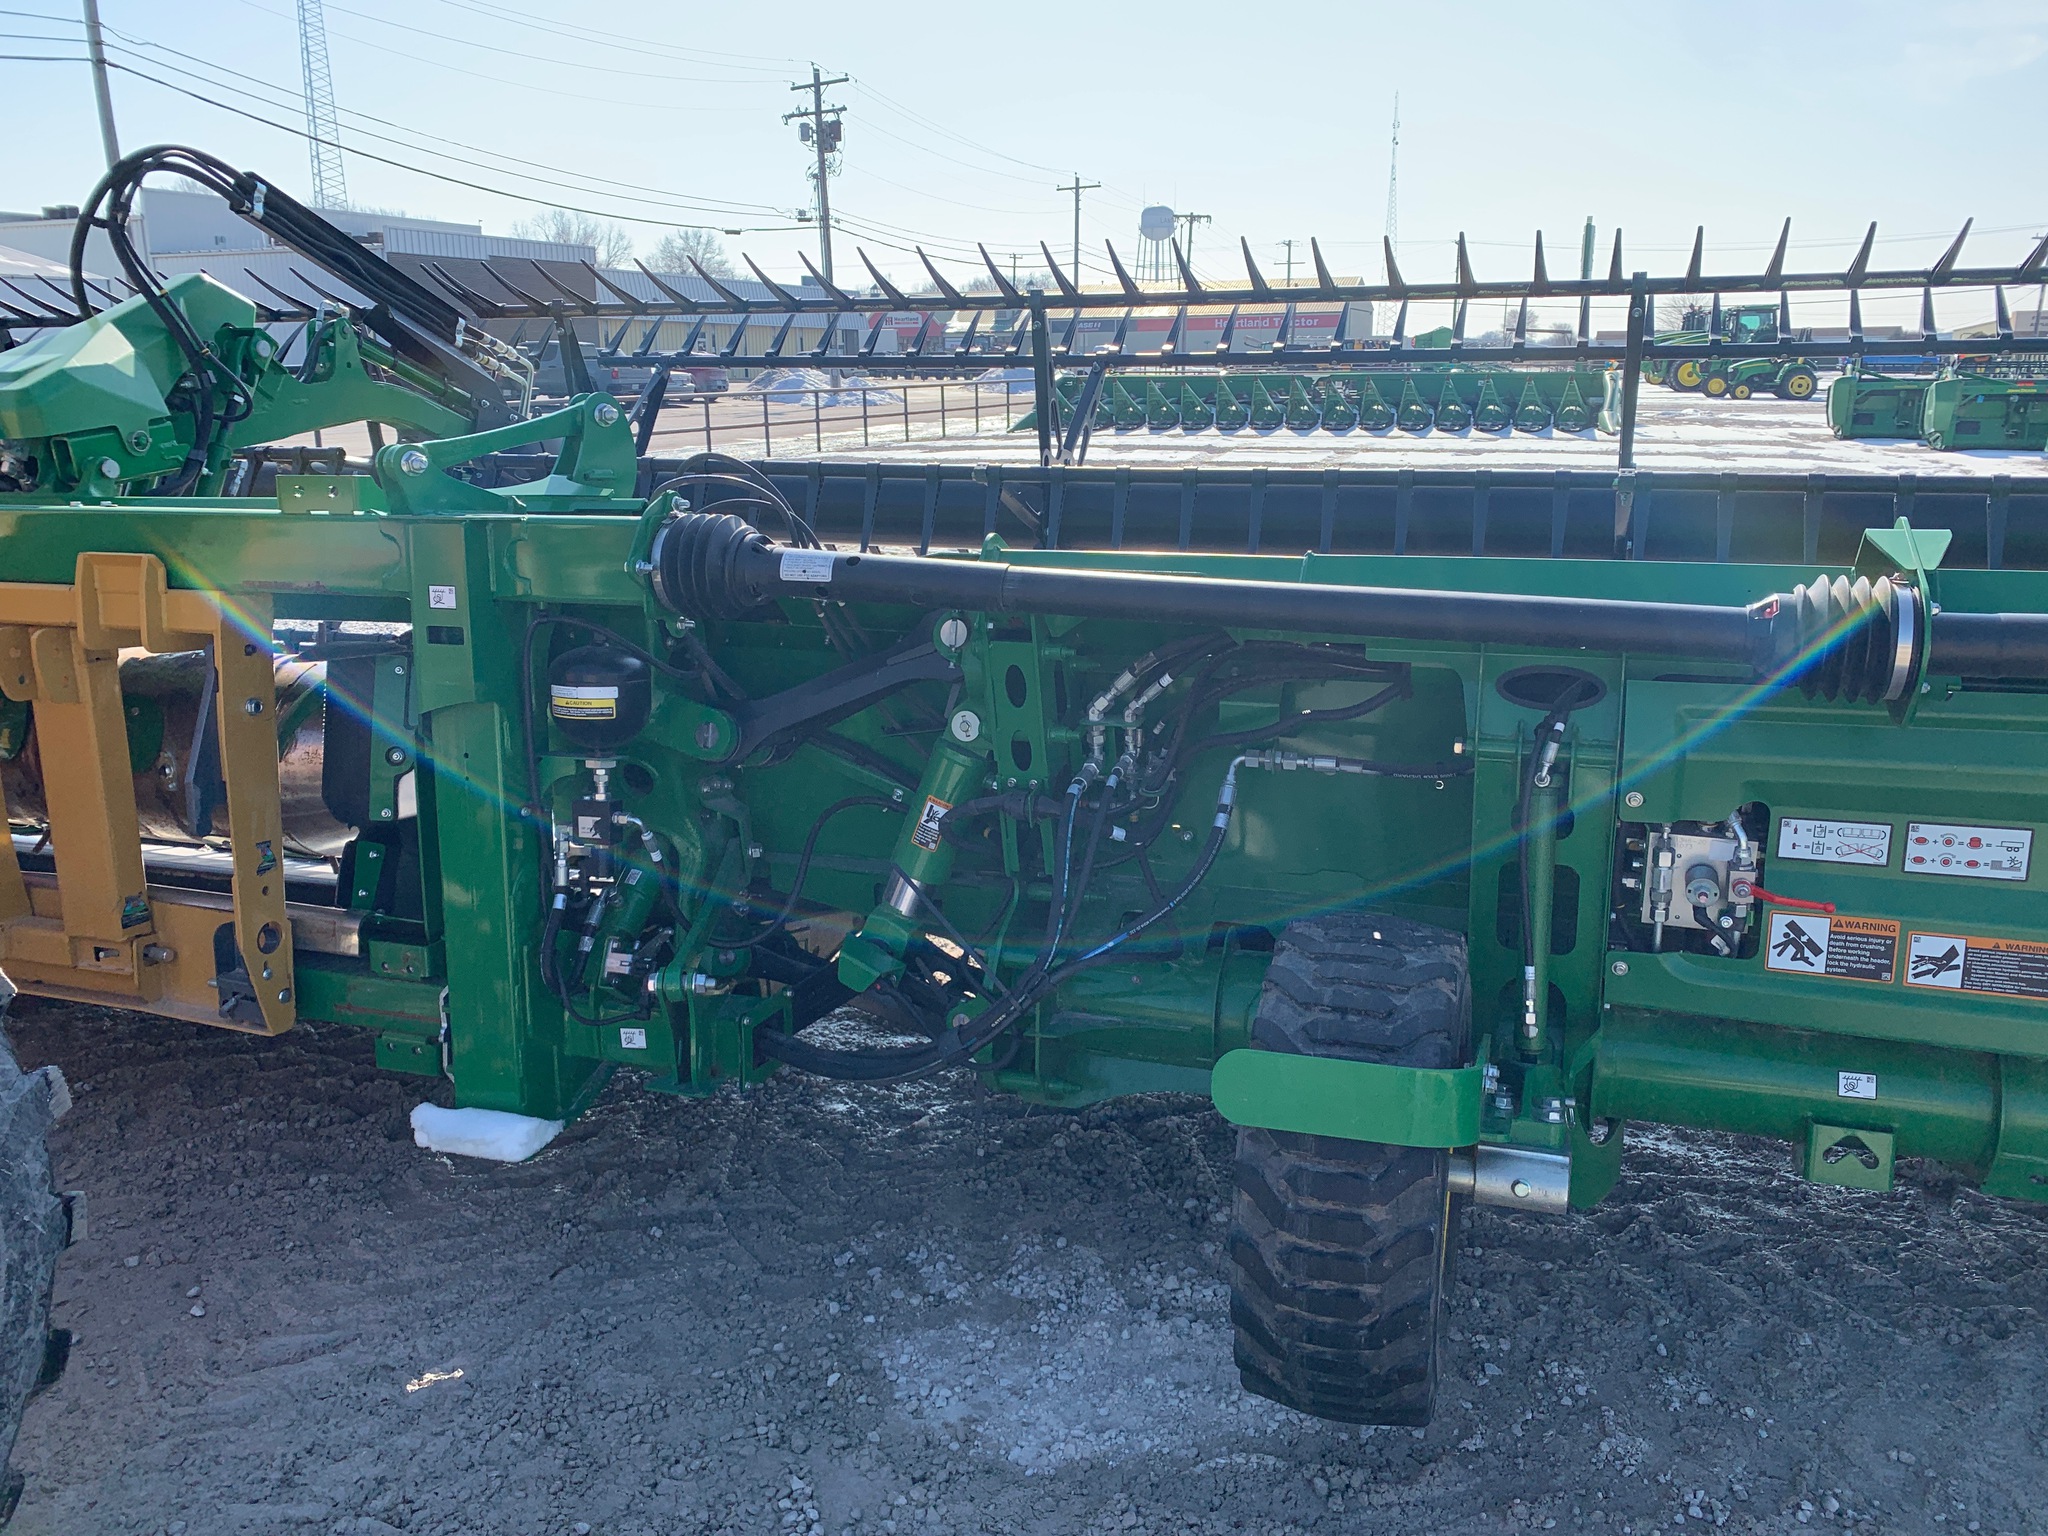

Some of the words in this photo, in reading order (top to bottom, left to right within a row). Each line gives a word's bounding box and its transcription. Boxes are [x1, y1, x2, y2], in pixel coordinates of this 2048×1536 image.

[1215, 318, 1270, 328] Hertland
[1845, 920, 1896, 933] WARNING
[1868, 936, 1885, 945] injury
[1827, 953, 1859, 961] underneath
[1847, 949, 1870, 957] working
